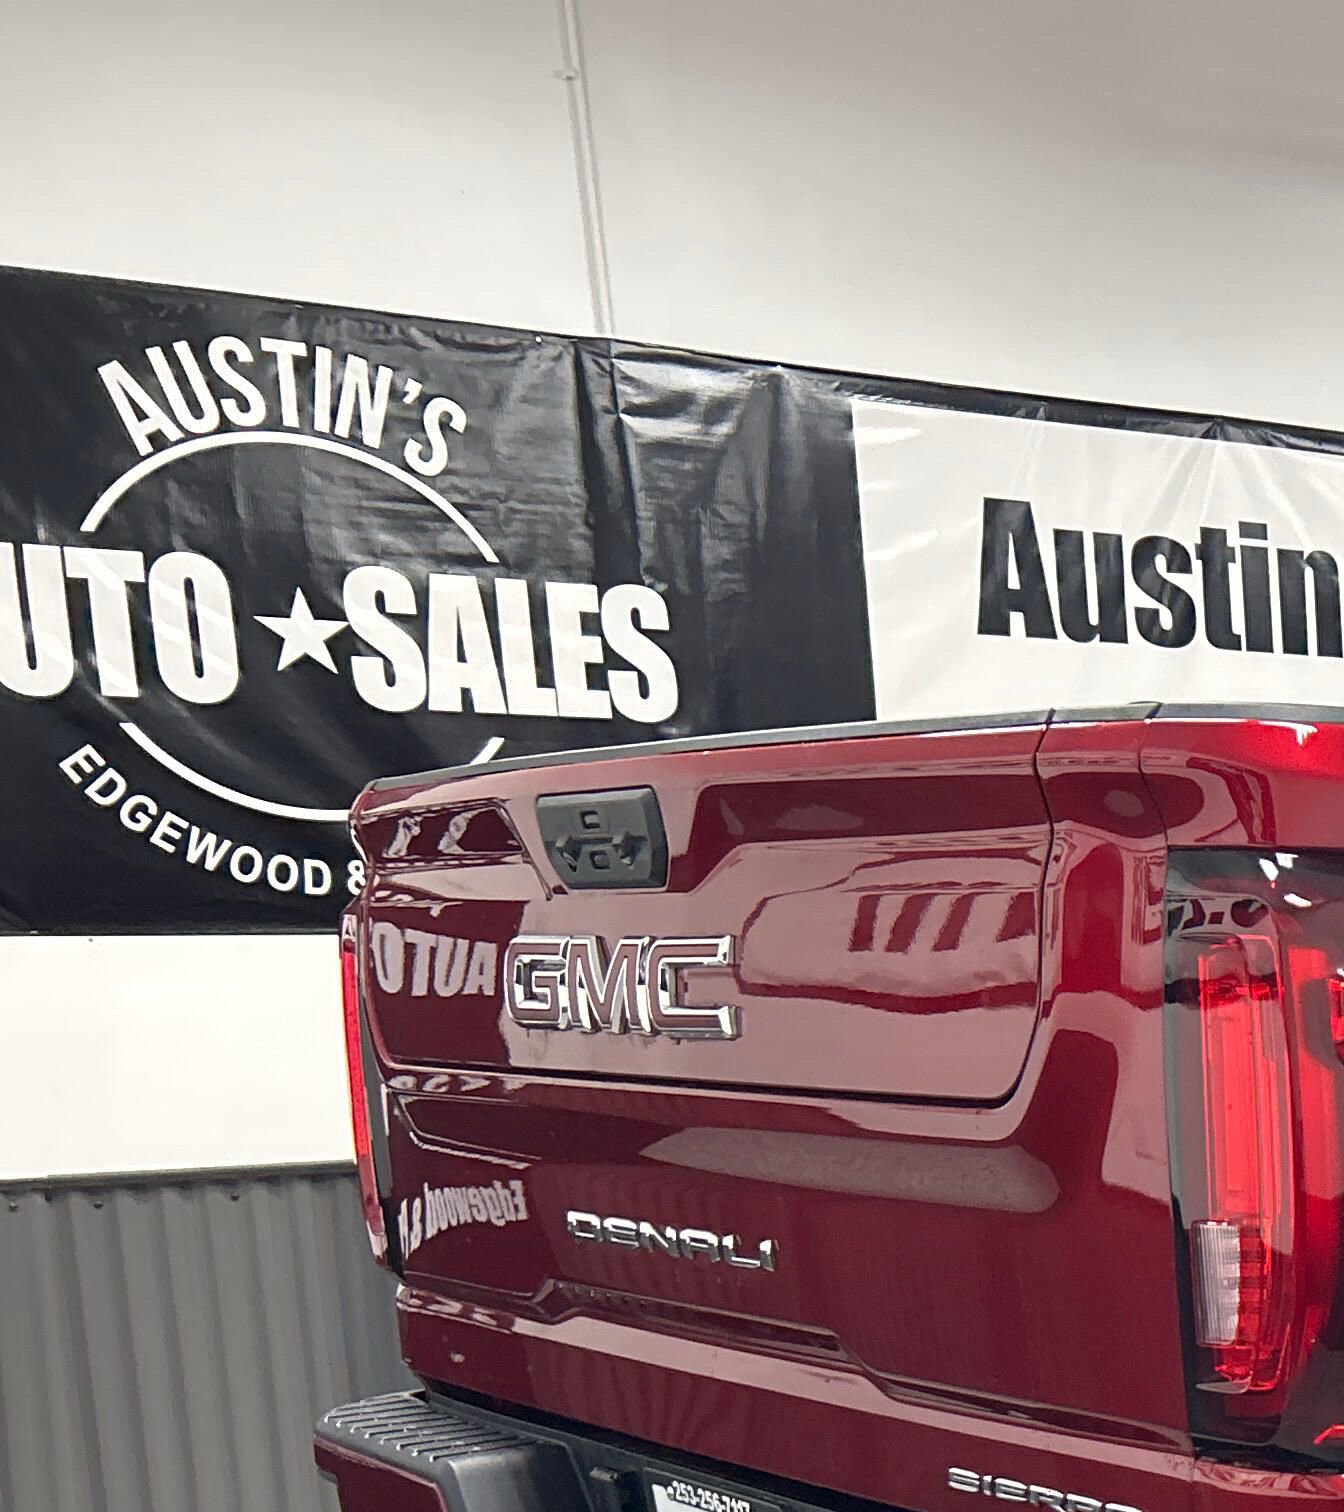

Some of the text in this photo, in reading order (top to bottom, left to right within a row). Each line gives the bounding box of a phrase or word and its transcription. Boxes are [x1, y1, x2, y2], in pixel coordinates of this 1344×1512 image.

[96, 336, 467, 477] AUSTIN'S
[342, 565, 680, 724] SALES
[57, 743, 334, 897] EDGEWOOD
[504, 934, 738, 1041] GMC
[567, 1210, 776, 1272] DENALI
